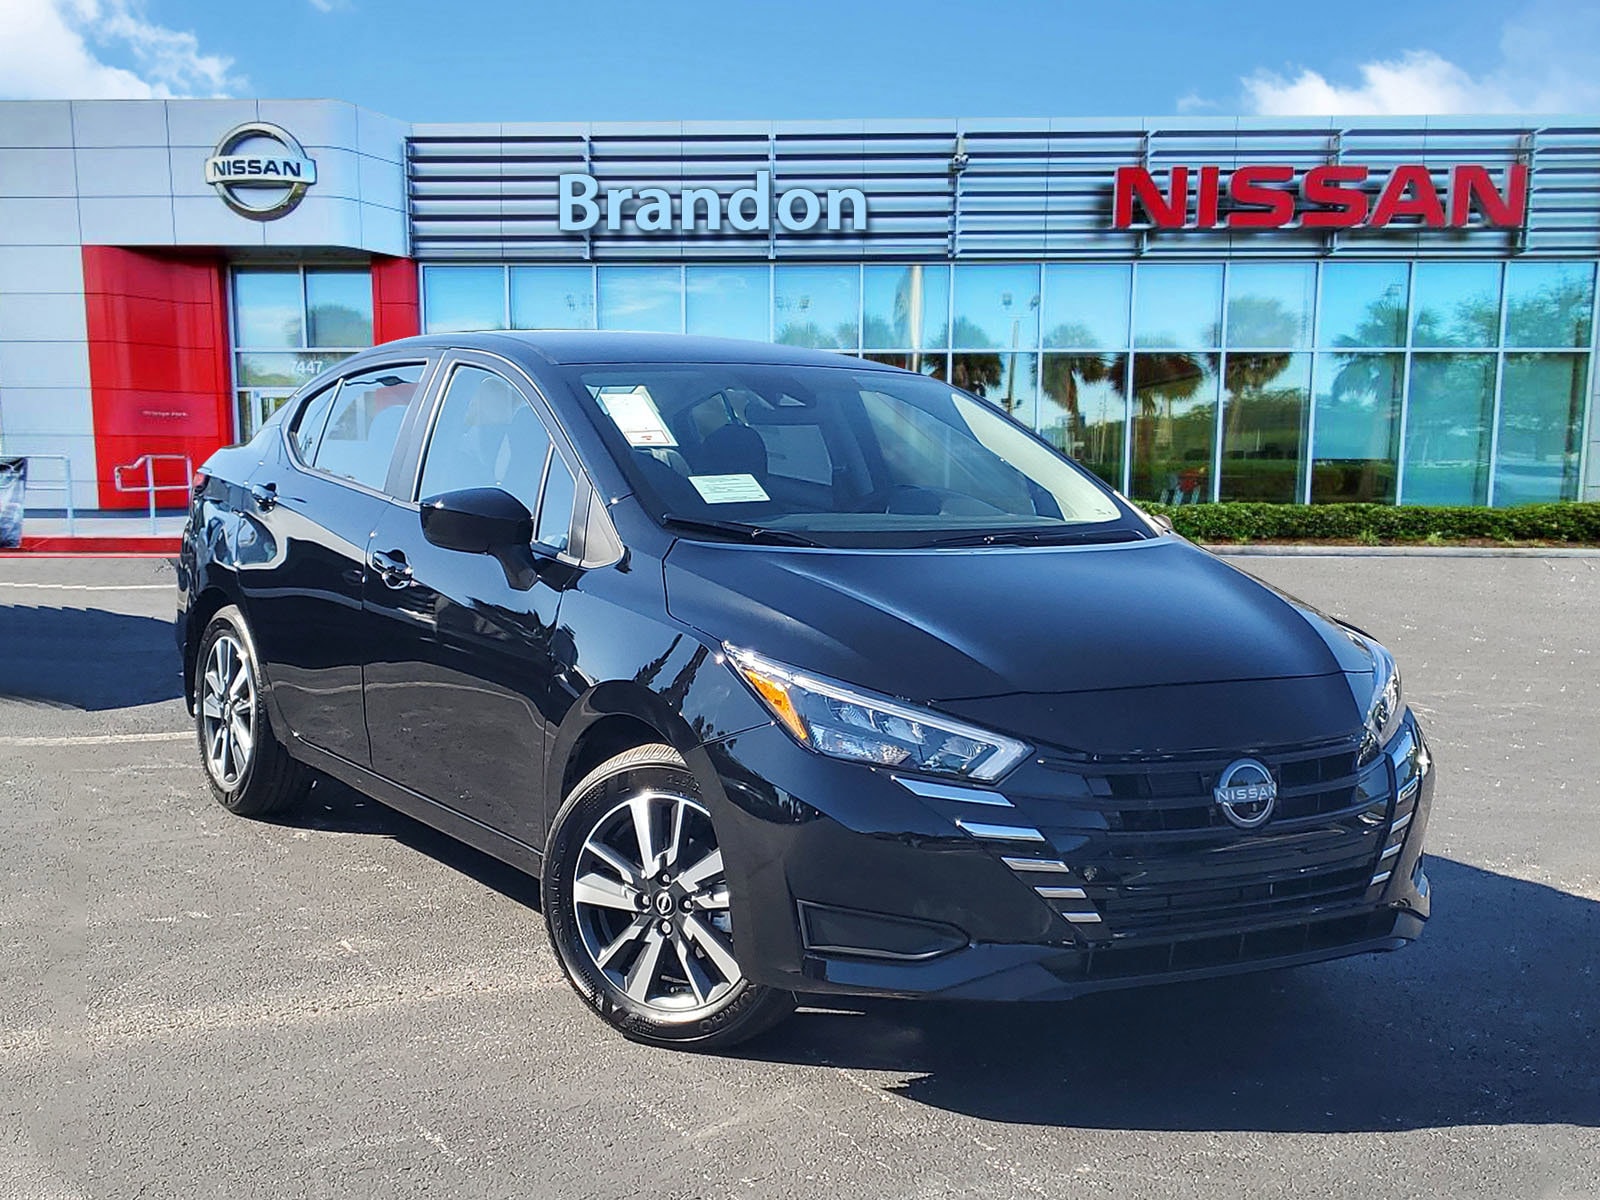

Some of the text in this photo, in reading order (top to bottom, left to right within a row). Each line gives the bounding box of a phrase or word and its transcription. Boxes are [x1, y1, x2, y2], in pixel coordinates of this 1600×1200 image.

[213, 160, 302, 177] NISSAN
[559, 170, 868, 232] Brandon
[1112, 165, 1528, 229] NISSAN
[293, 361, 323, 374] 7447
[1217, 785, 1276, 802] NISSAN
